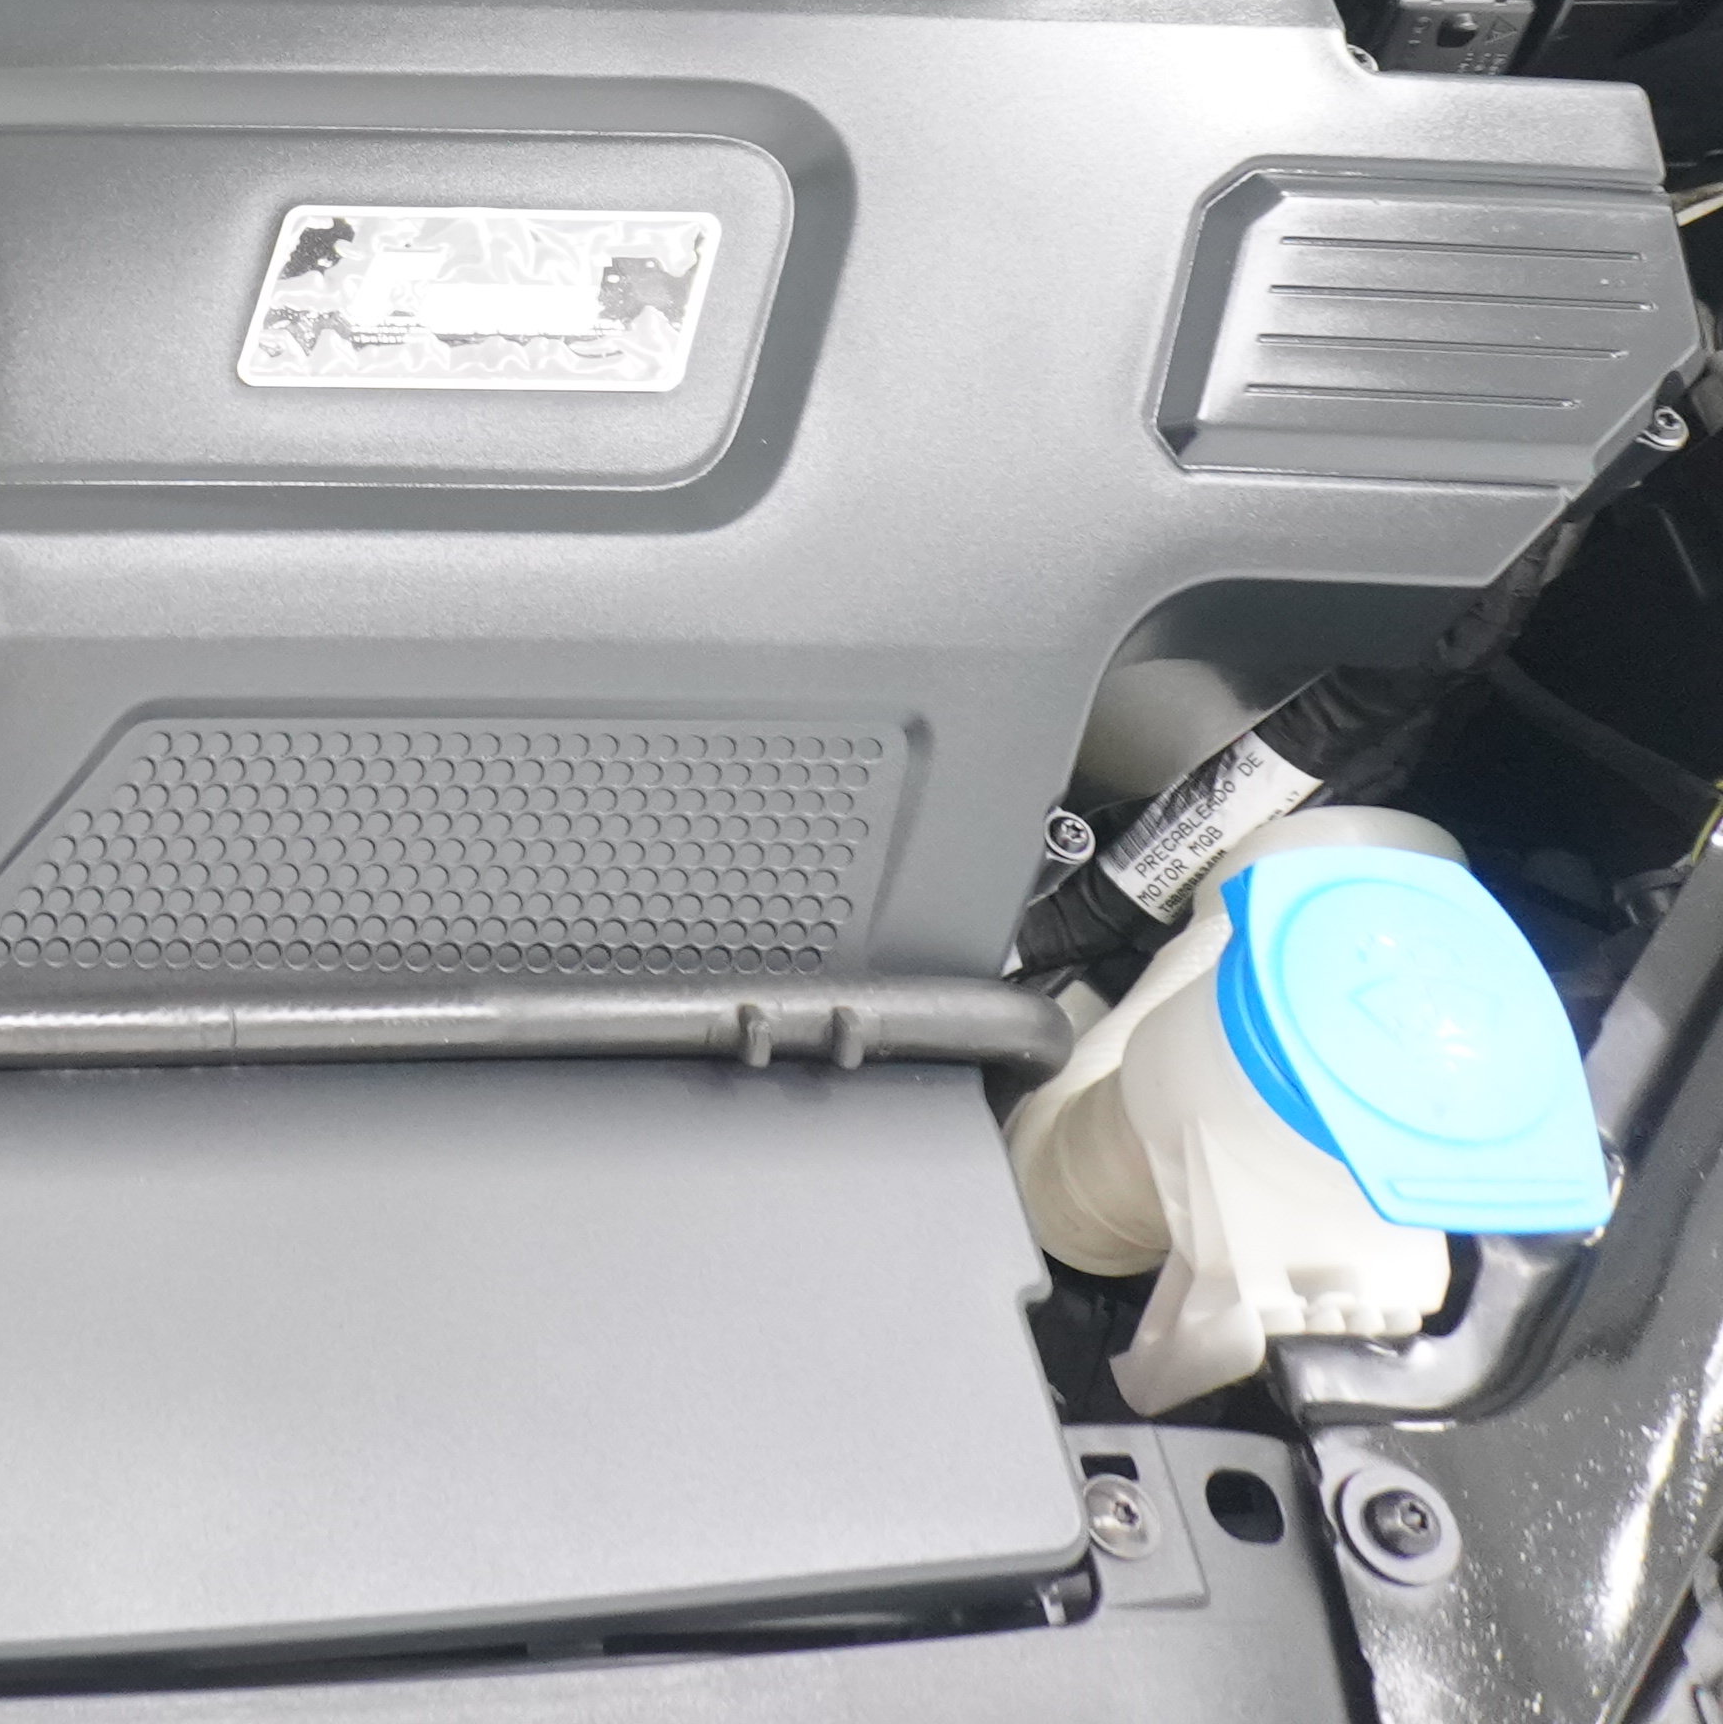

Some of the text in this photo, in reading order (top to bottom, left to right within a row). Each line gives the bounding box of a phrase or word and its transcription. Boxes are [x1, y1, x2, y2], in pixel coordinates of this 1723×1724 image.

[1132, 751, 1264, 879] PRECABLEADO DE
[1137, 823, 1227, 908] MOTOR MQB
